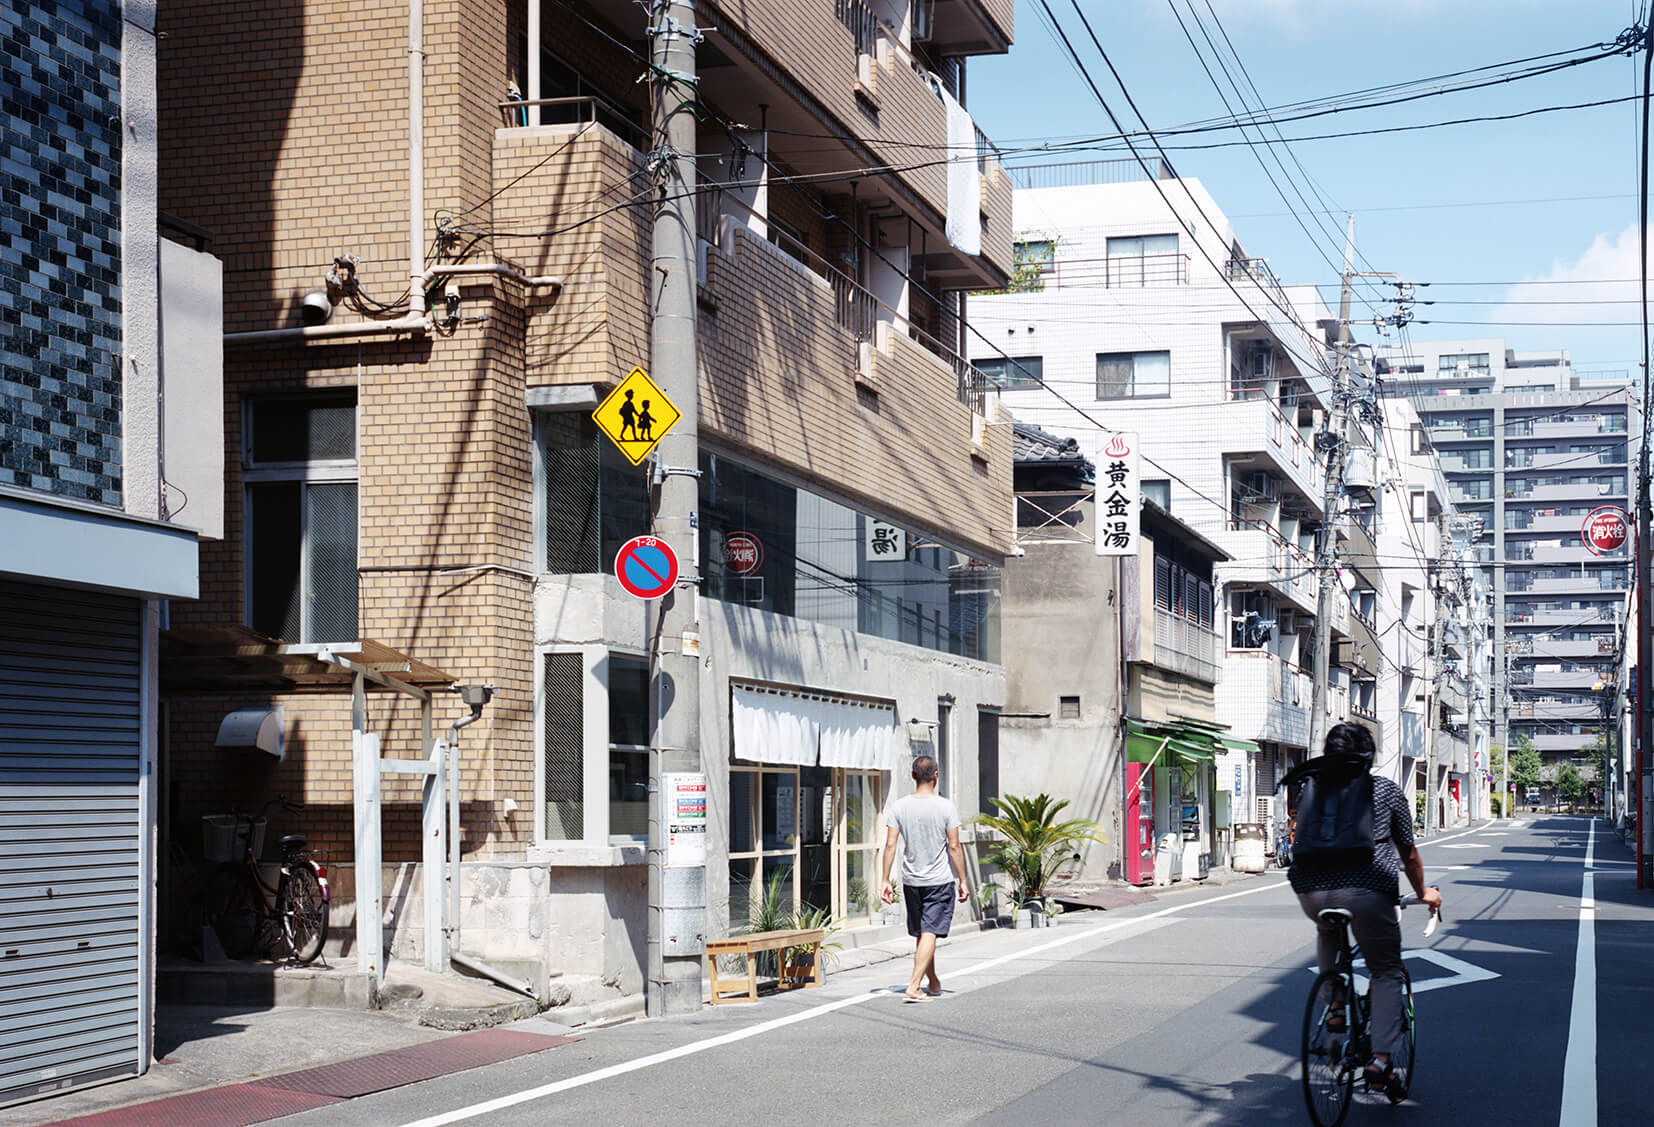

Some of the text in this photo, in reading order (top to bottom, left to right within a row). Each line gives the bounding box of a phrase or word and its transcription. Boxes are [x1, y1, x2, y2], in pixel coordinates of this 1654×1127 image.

[1103, 460, 1131, 549] 黄金湯
[1592, 523, 1625, 541] 消火栓
[634, 538, 657, 548] 7-20
